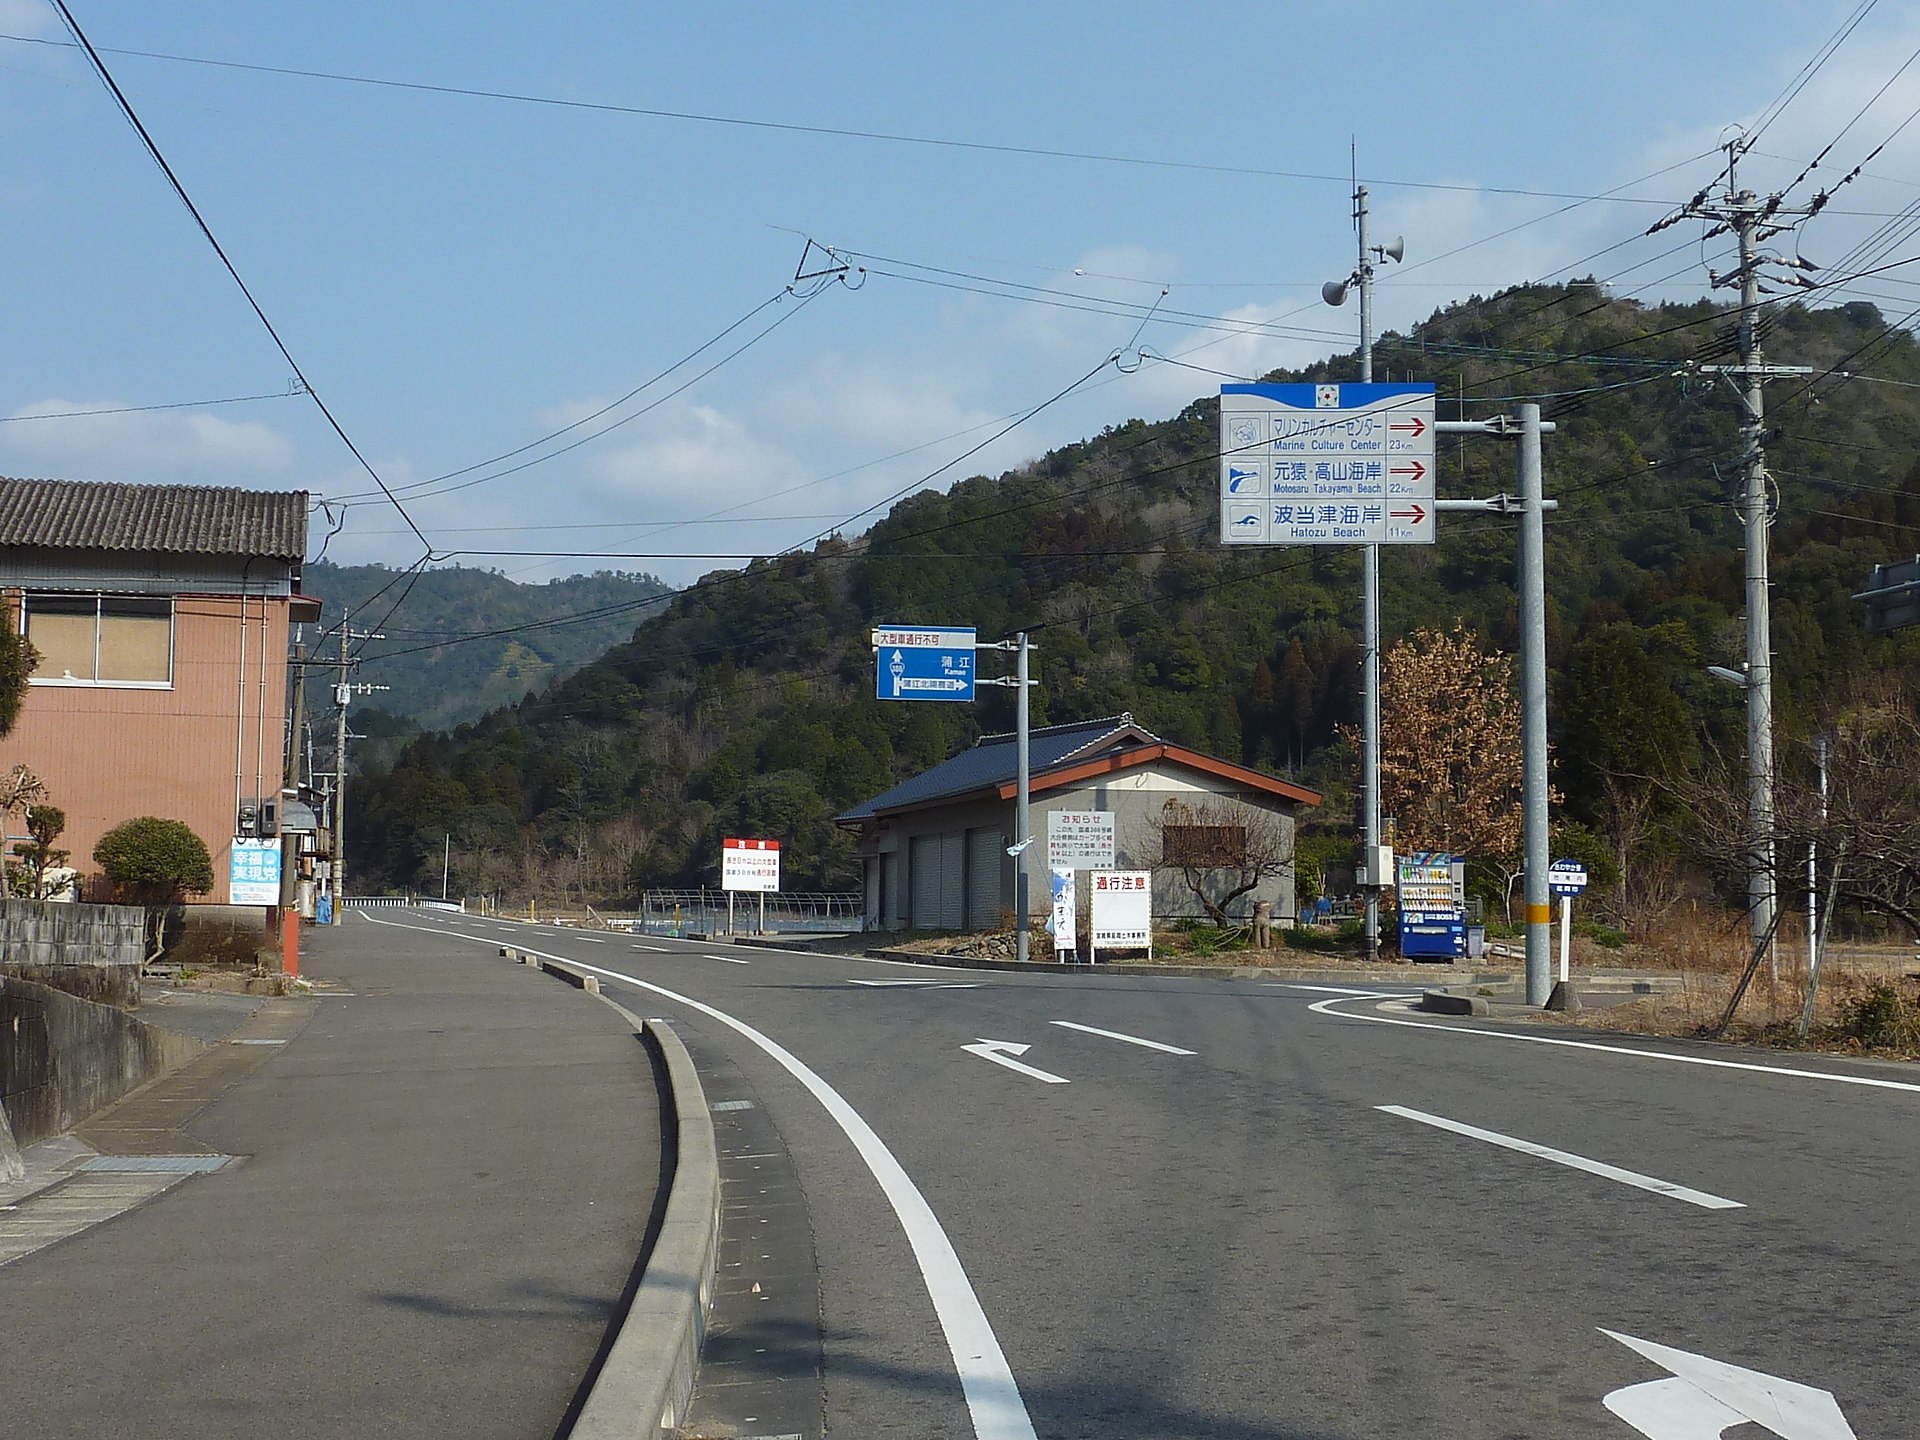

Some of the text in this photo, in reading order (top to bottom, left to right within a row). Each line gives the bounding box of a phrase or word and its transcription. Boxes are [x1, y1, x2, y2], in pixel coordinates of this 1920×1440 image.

[1273, 418, 1382, 437] マリンカルチャーセンター
[1274, 440, 1382, 450] Marine Culture Center
[1273, 484, 1382, 495] Motosaru Takayama Beach
[1274, 505, 1382, 525] 波当津海岸
[1290, 527, 1365, 537] Hatozu Beach
[880, 633, 940, 646] 大型車通行不可
[1061, 815, 1102, 824] お知らせ
[233, 850, 263, 865] 幸福
[233, 866, 278, 881] 実現党
[1096, 876, 1146, 890] 通行注意
